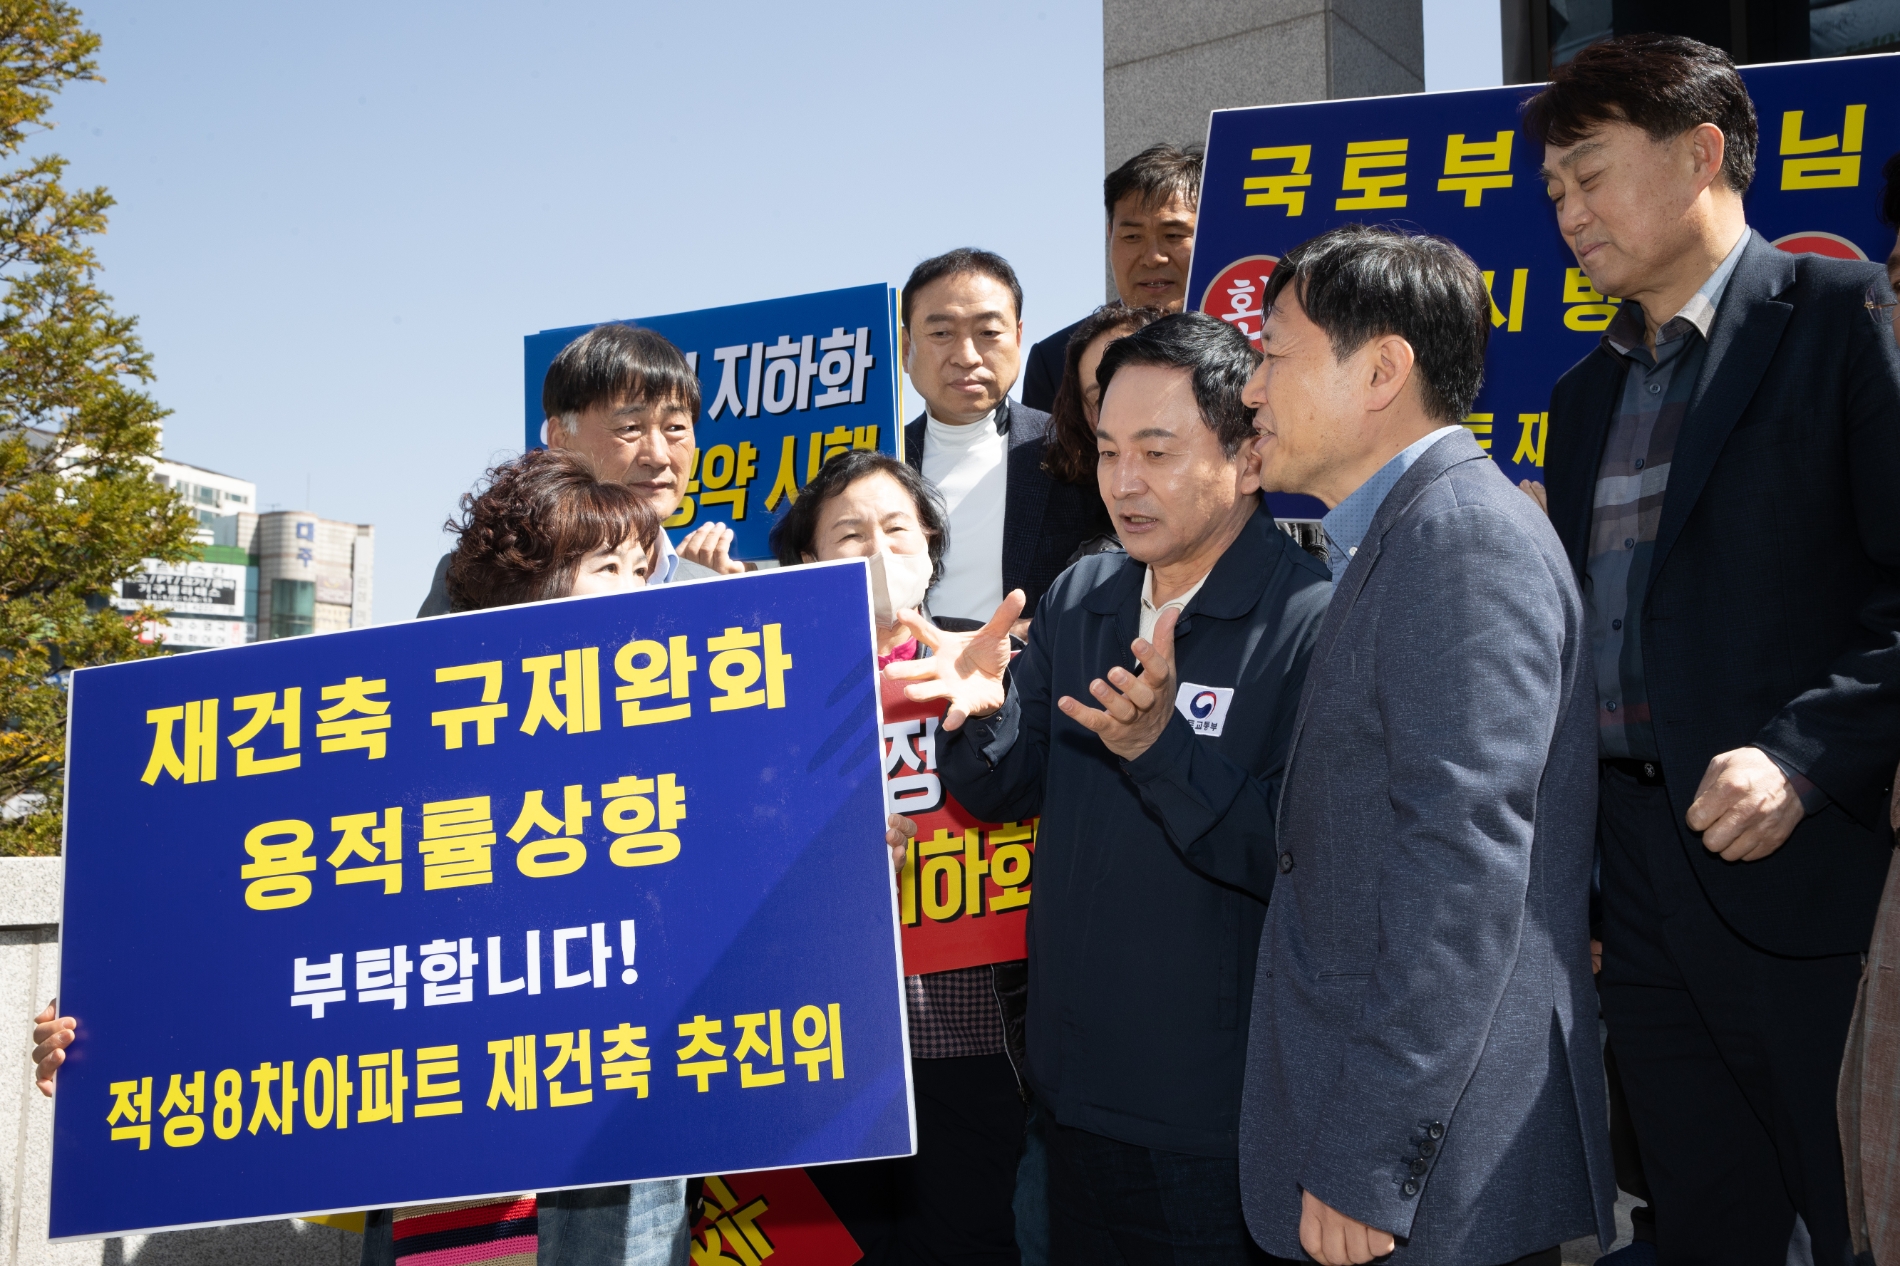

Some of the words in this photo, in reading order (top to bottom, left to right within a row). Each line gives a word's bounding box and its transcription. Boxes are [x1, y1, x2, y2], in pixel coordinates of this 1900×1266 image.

[1243, 131, 1514, 216] 국토부
[708, 326, 873, 420] 지하화
[296, 522, 315, 568] 대주
[141, 677, 391, 785] 재건축
[431, 624, 792, 749] 규제완화
[242, 774, 686, 911] 용적률상향
[290, 919, 638, 1019] 부탁합니다!
[106, 1045, 463, 1150] 적성8차아파트
[487, 1024, 651, 1111] 재건축
[677, 1003, 844, 1093] 추진위
